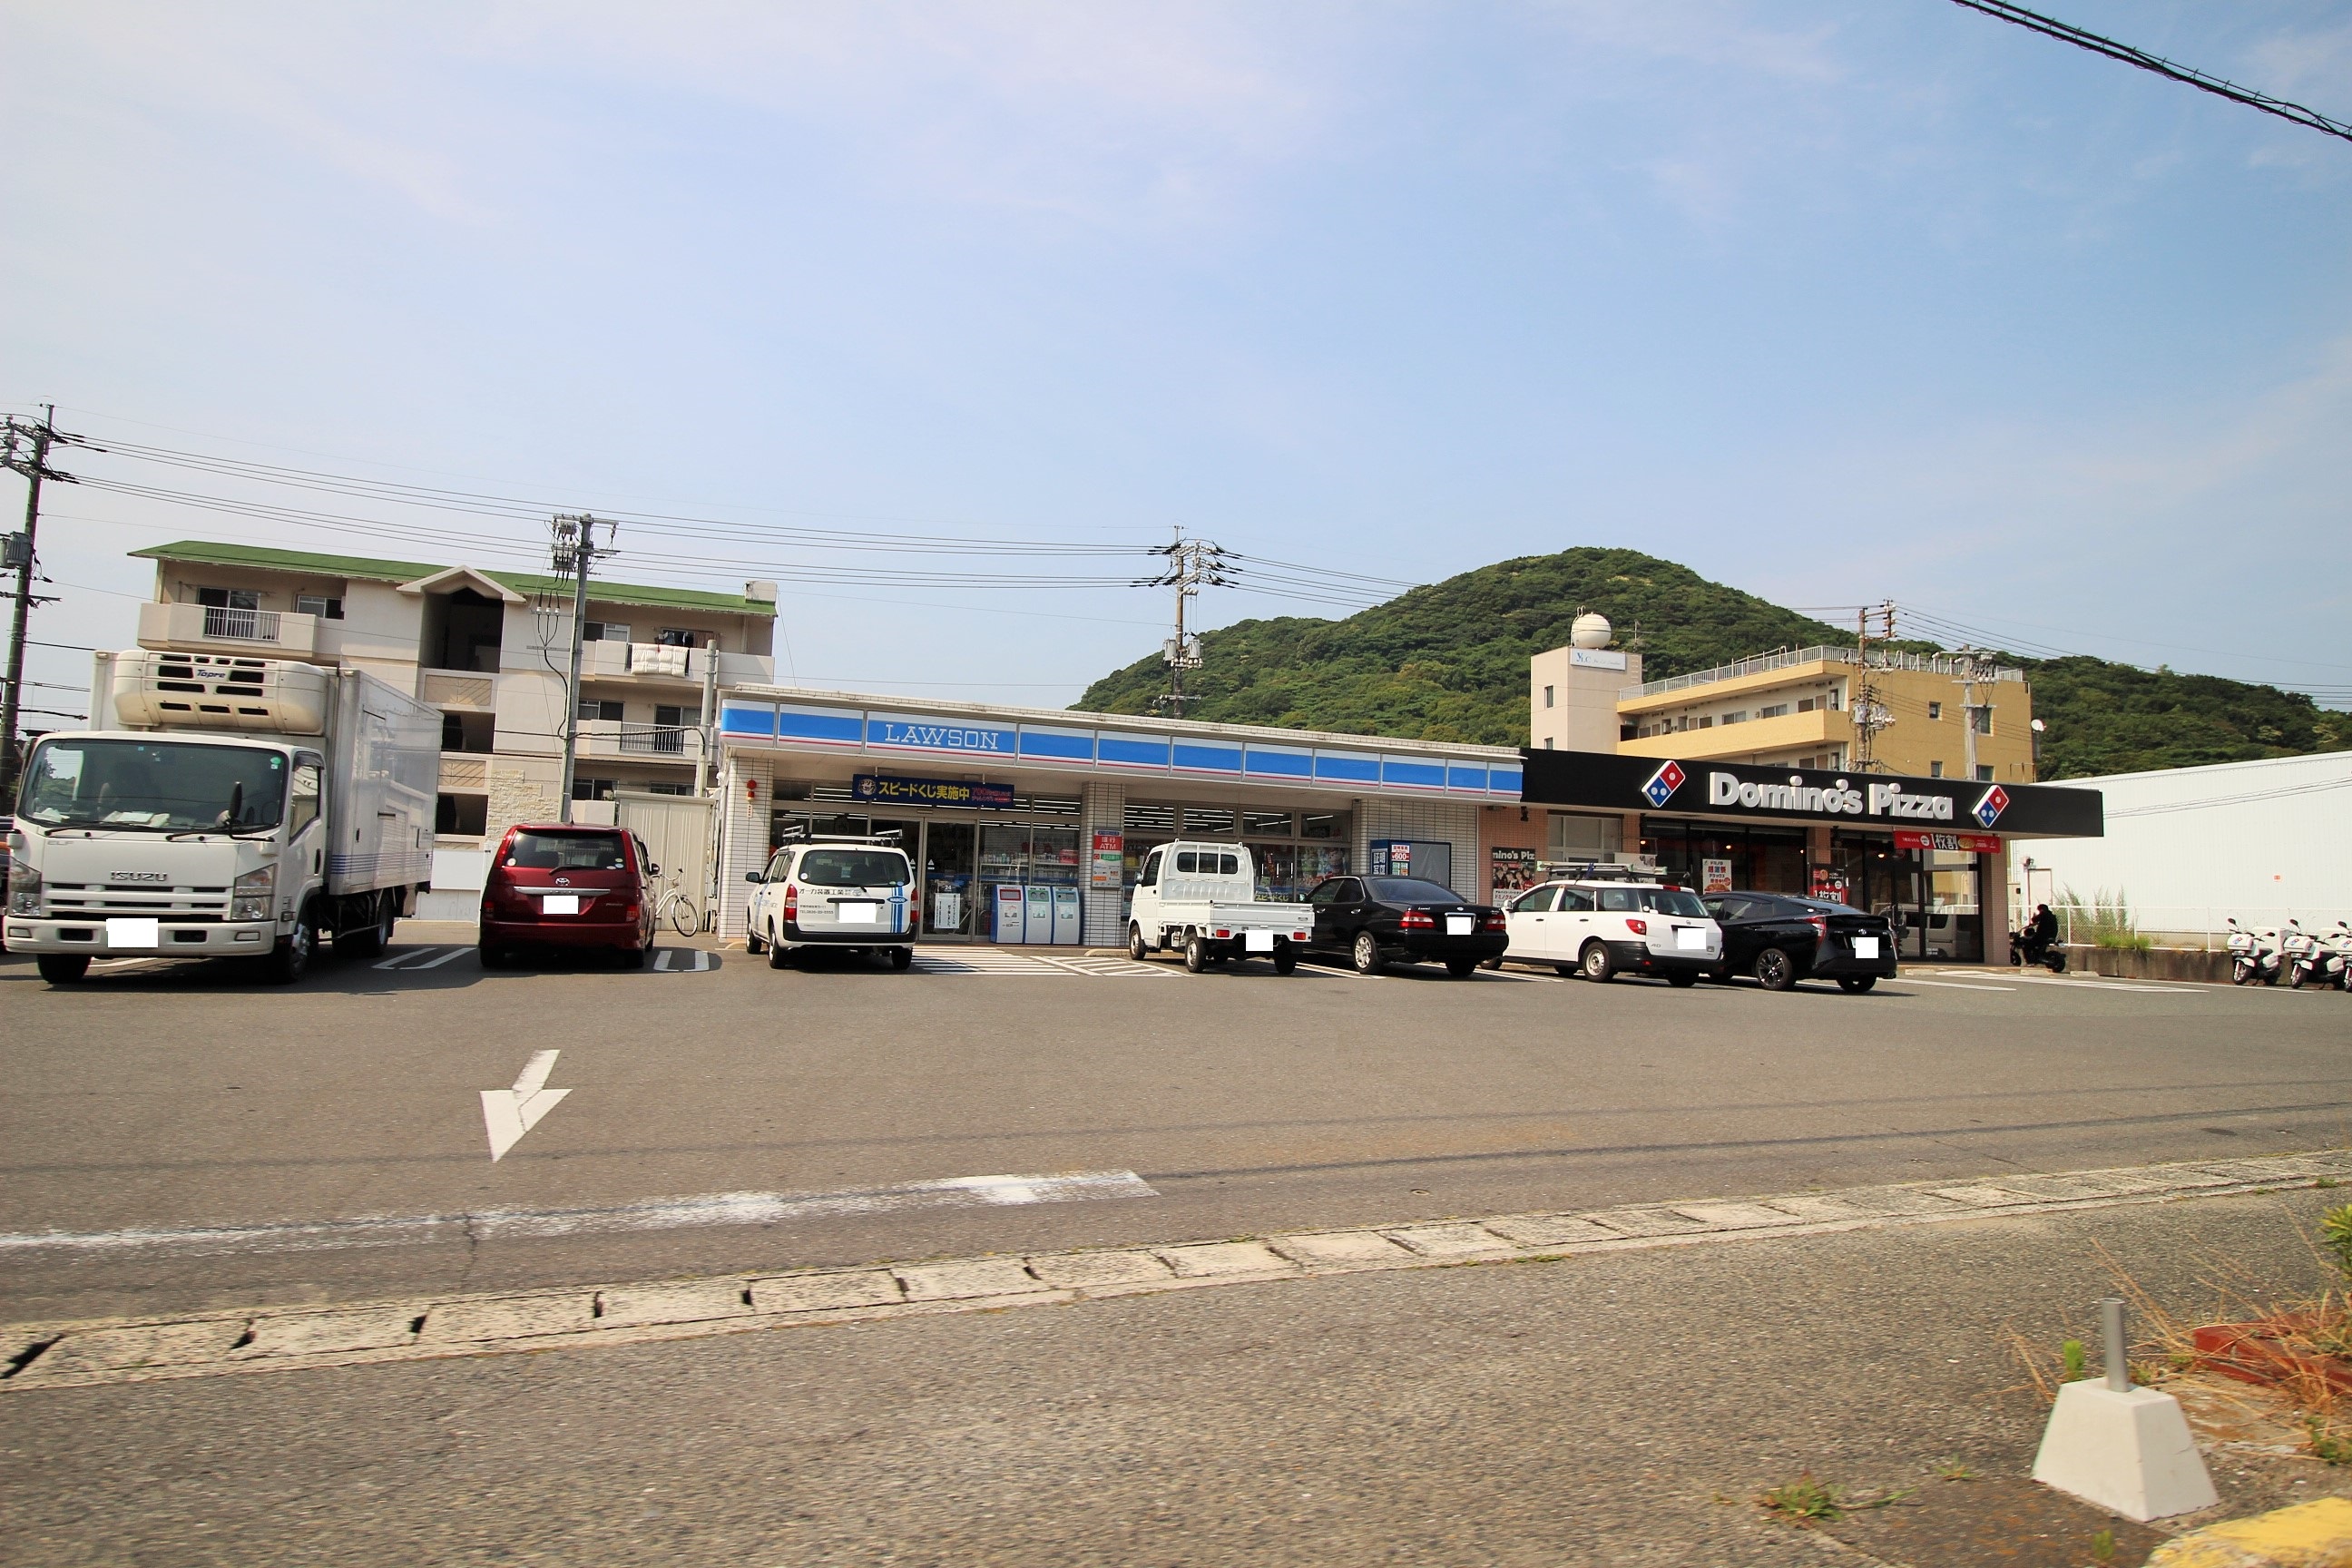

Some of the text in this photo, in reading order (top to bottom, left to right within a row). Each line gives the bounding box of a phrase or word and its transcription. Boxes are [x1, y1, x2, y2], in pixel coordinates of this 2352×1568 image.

[885, 724, 999, 750] LAWSON
[878, 781, 970, 801] スピードくじ実施中
[1710, 771, 1953, 820] Domino's Pizza
[1930, 833, 1959, 850] 1枚割
[1521, 851, 1535, 860] Piz
[111, 870, 169, 882] ISUZU
